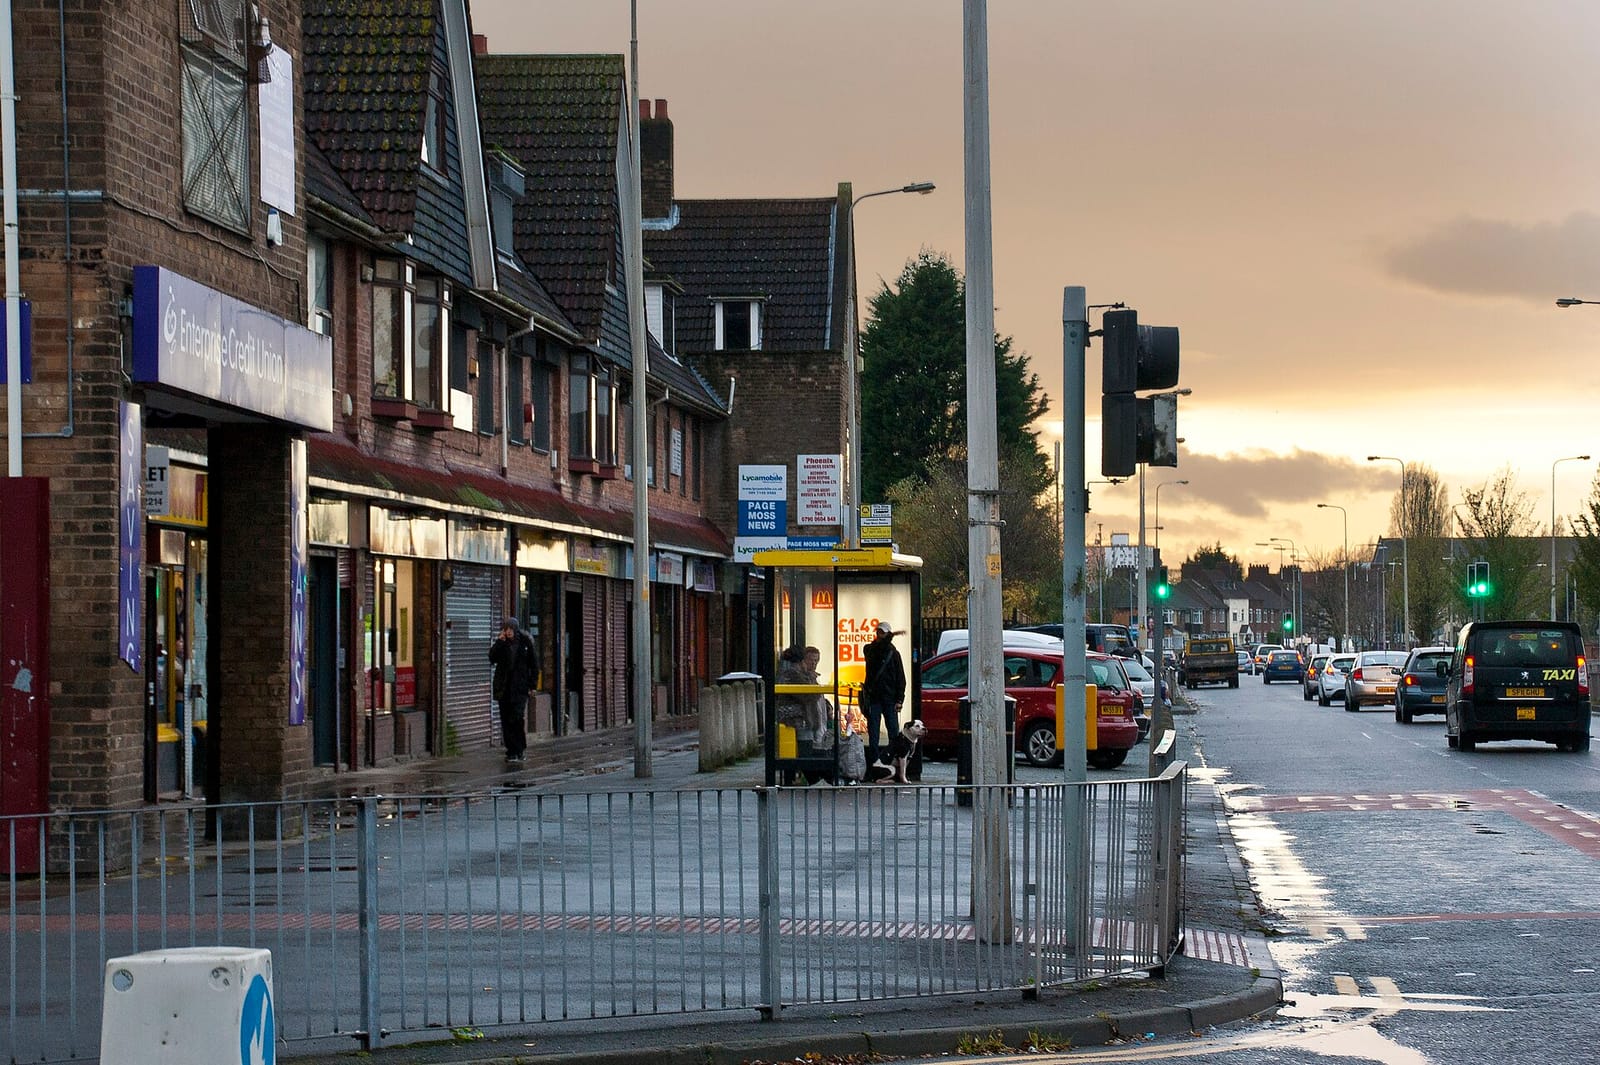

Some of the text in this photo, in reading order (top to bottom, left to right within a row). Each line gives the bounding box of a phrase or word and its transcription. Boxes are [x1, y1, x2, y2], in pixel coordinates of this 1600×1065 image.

[180, 308, 283, 384] Enterprise Credit Union
[146, 466, 167, 482] ET
[742, 474, 783, 482] Lycamobile
[748, 502, 776, 510] PAGE
[748, 511, 776, 520] MOSS
[748, 521, 776, 530] NEWS
[838, 618, 879, 633] £1.49
[838, 644, 866, 662] BL
[1542, 669, 1576, 681] TAXI
